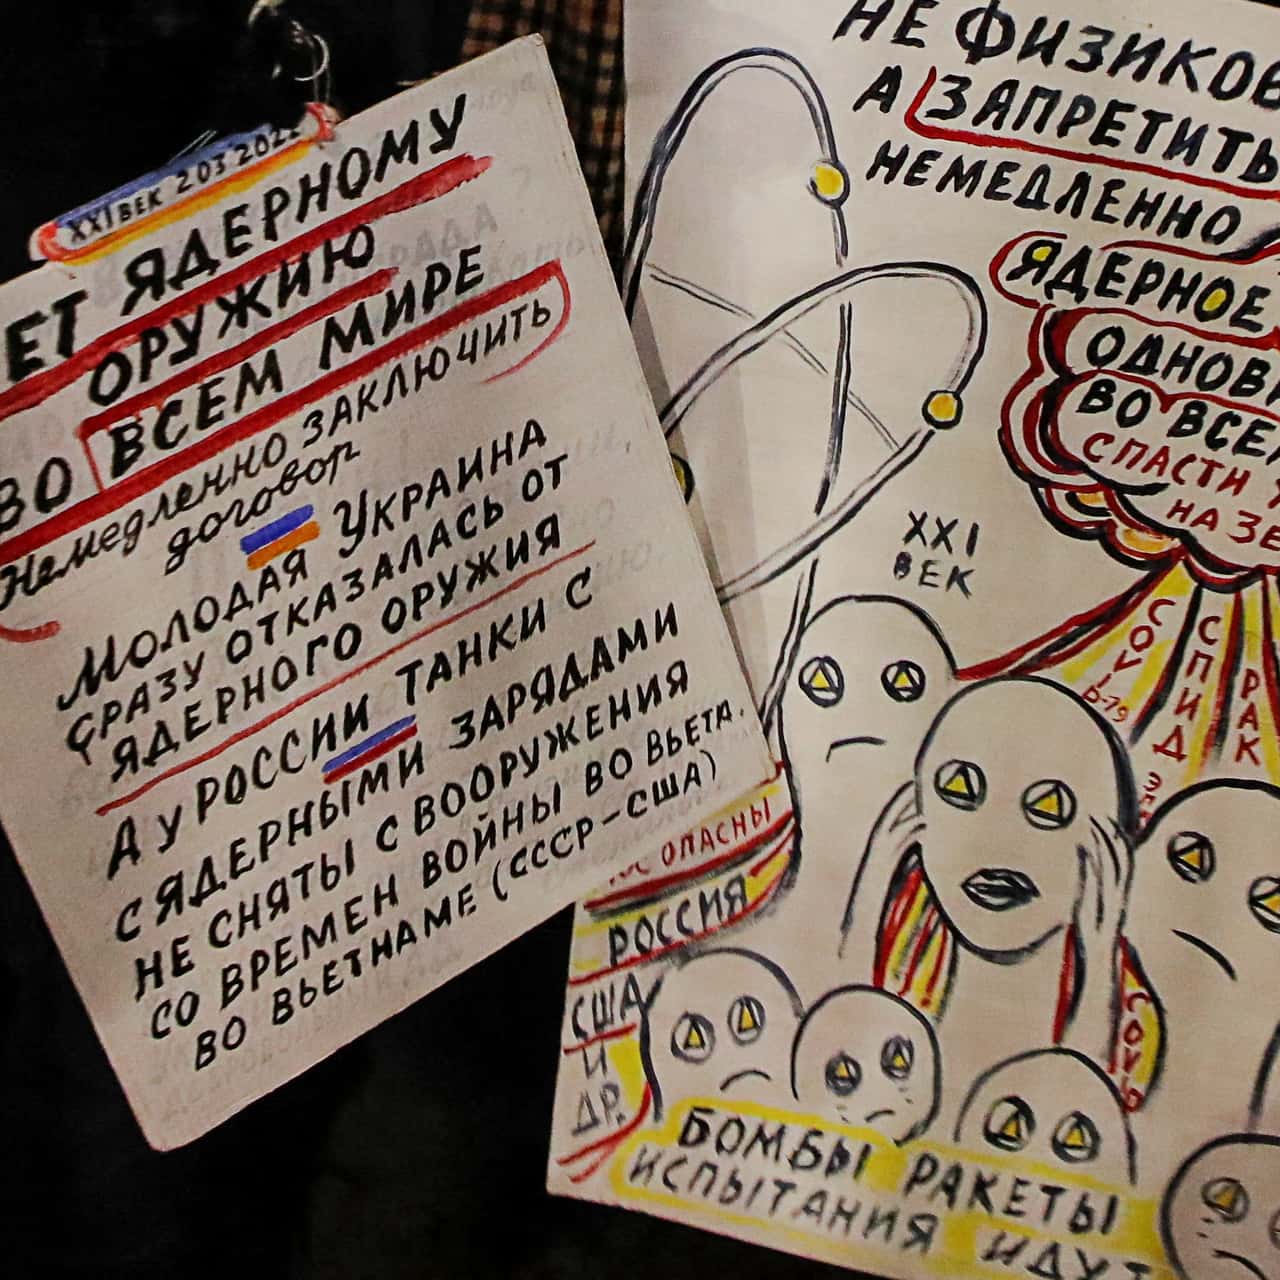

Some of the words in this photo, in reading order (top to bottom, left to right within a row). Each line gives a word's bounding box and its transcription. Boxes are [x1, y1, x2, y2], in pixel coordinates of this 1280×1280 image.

[853, 64, 903, 113] А
[925, 73, 1279, 183] ЗАПРЕТИТЬ
[121, 94, 467, 316] ЯДЕРНОМУ
[865, 139, 1241, 245] НЕМЕДЛЕННО
[88, 224, 375, 406] ОРУЖИЮ
[1006, 239, 1272, 333] ЯДЕРНОЕ
[108, 349, 283, 479] ВСЕМ
[319, 245, 484, 370] МИРЕ
[1075, 378, 1152, 429] ВО
[1082, 432, 1252, 497] СПАСТИ
[1167, 498, 1218, 534] НА
[225, 495, 503, 663] ОТКАЗАЛАСЬ
[522, 454, 568, 502] ОТ
[893, 551, 976, 600] ВЕК
[112, 623, 362, 783] ЯДЕРНОГО
[381, 513, 561, 634] ОРУЖИЯ
[197, 693, 369, 825] РОССИИ
[395, 598, 546, 706] ТАНКИ
[566, 567, 593, 610] С
[449, 602, 678, 750] ЗАРЯДАМИ
[1152, 615, 1221, 762] СПИД
[1234, 668, 1261, 766] РАК
[135, 935, 195, 1002] НЕ
[208, 838, 354, 948] СНЯТЫ
[414, 660, 688, 836] ВООРУЖЕНИЯ
[661, 797, 771, 866] ОПАСНЫ
[152, 990, 200, 1039] СО
[220, 873, 399, 1010] ВРЕМЕН
[422, 782, 561, 889] ВОЙНЫ
[585, 748, 632, 796] ВО
[608, 875, 748, 967] РОССИЯ
[195, 1016, 246, 1071] ВО
[272, 883, 477, 1026] ВЬЕТНАМЕ
[572, 973, 645, 1040] США
[628, 1143, 940, 1253] ИСПЫТАНИЯ
[678, 1106, 872, 1180] БОМБЫ
[902, 1152, 1119, 1235] РАКЕТЫ
